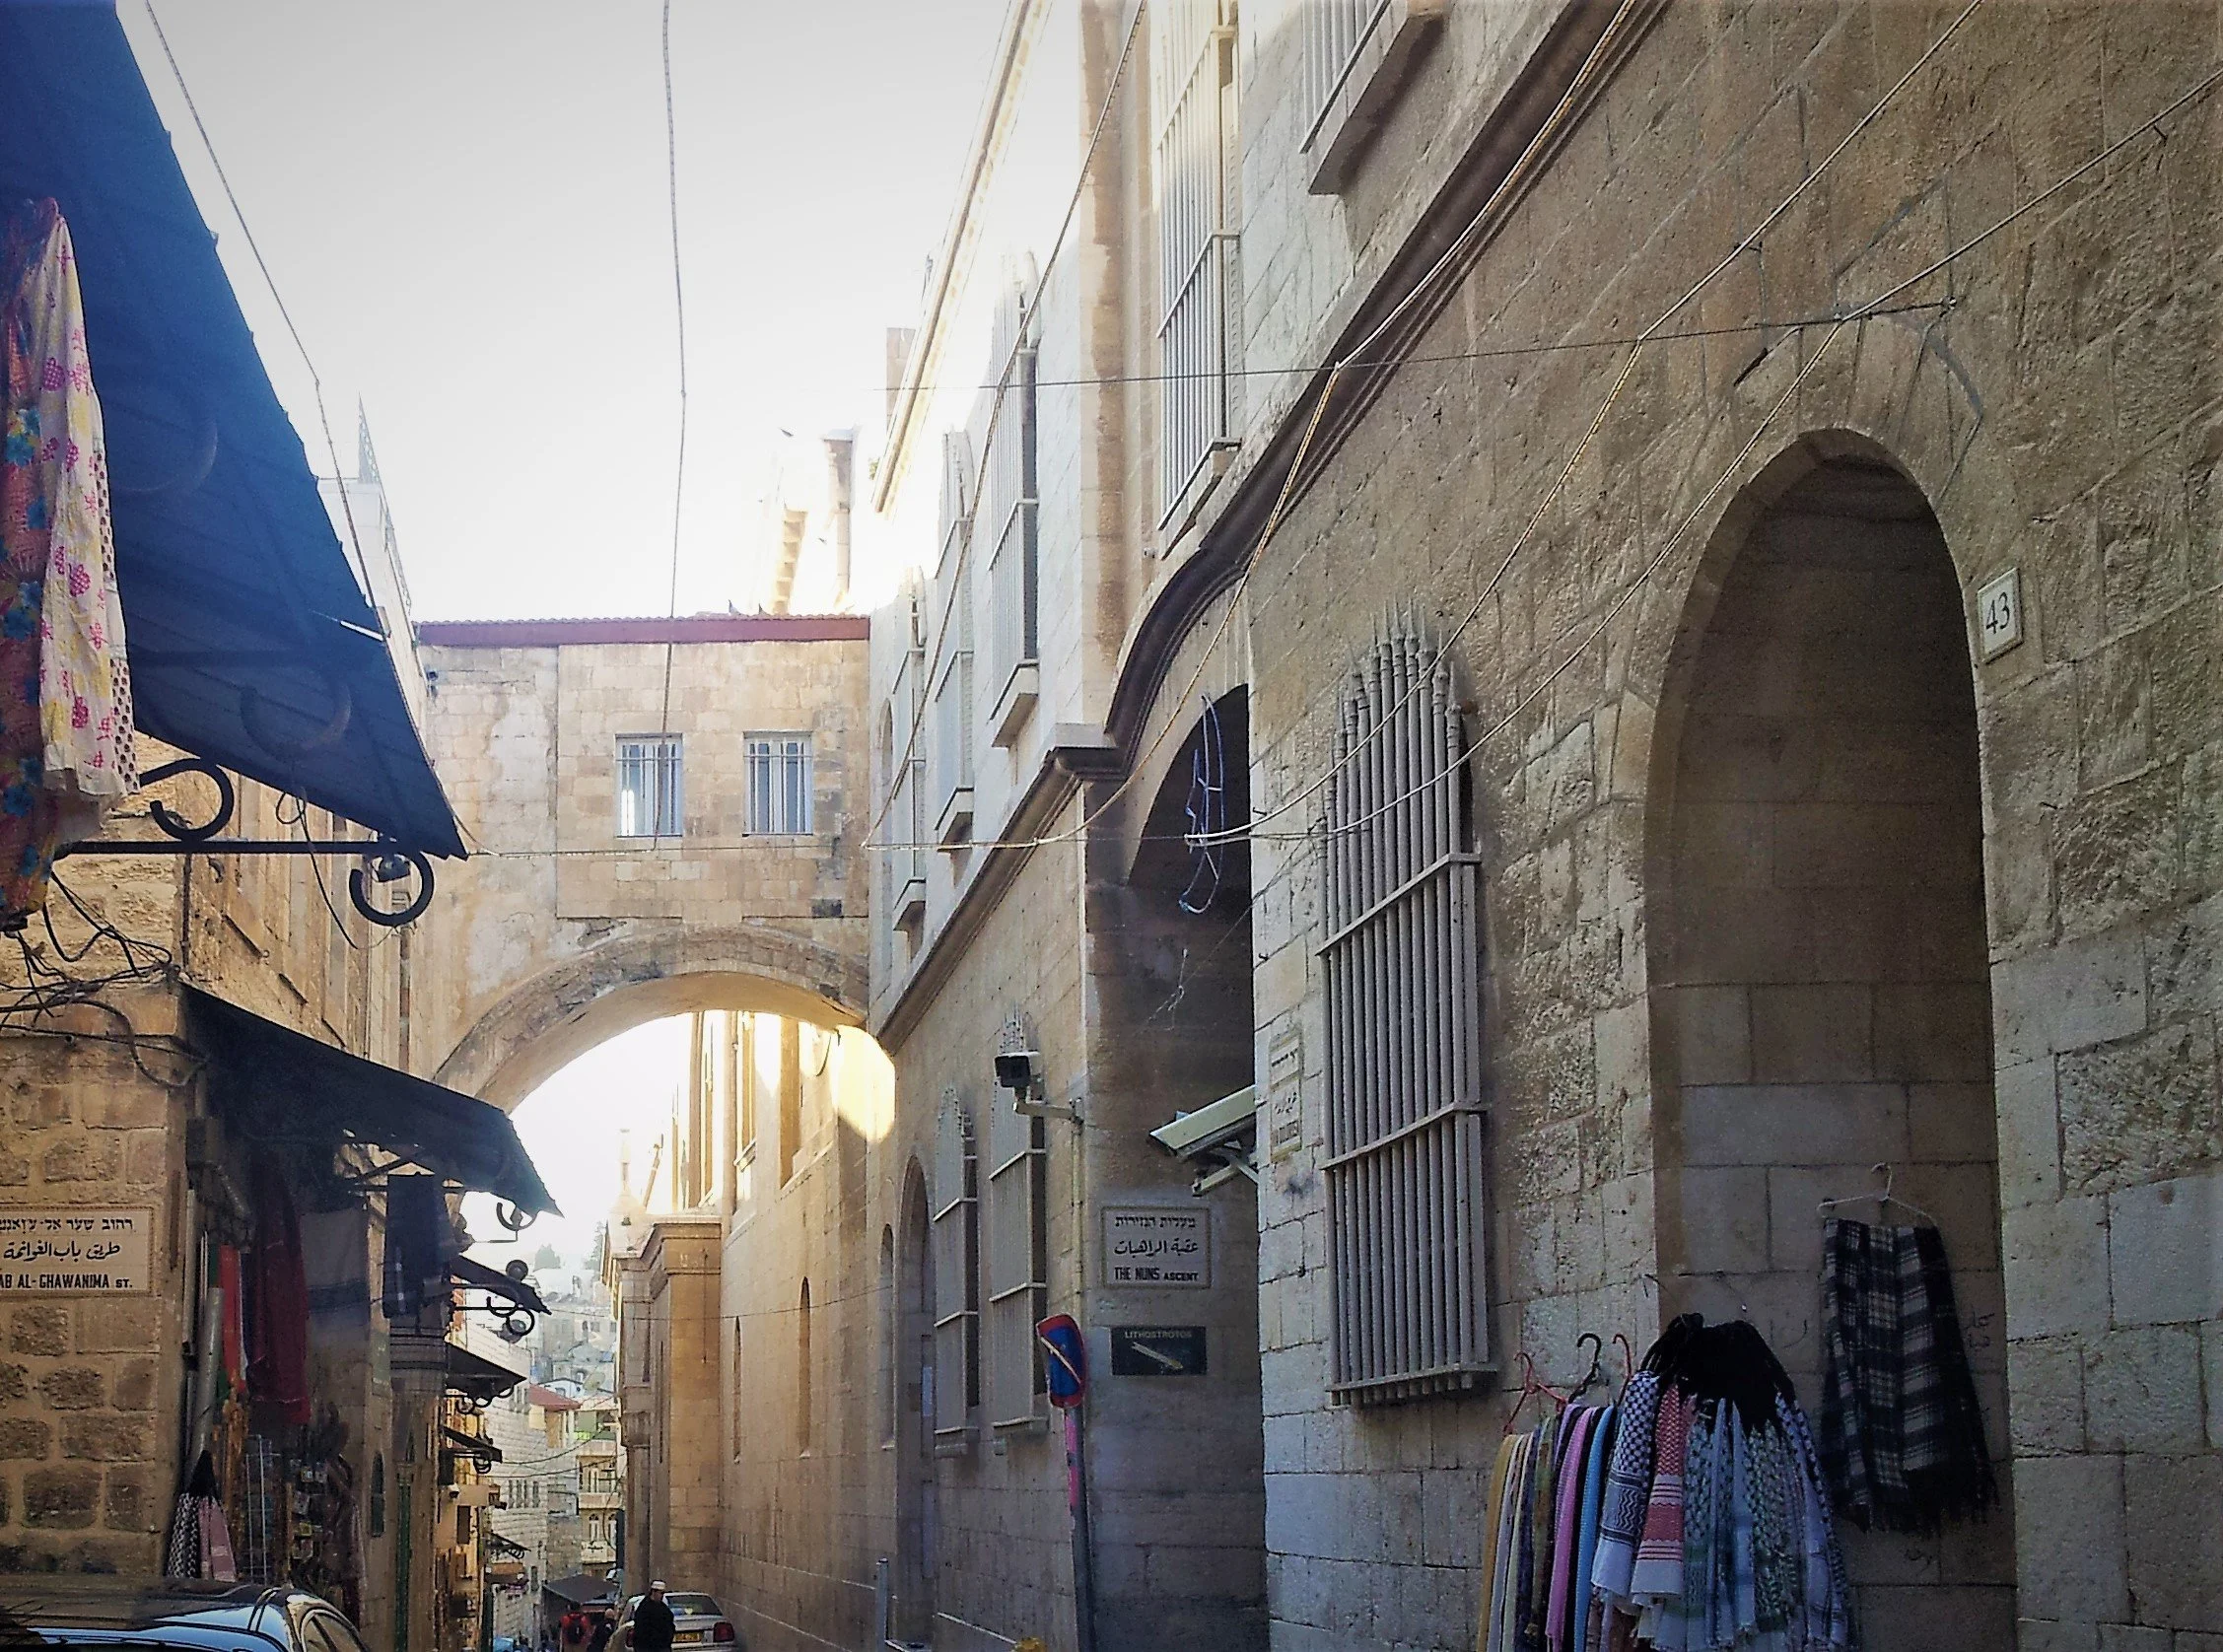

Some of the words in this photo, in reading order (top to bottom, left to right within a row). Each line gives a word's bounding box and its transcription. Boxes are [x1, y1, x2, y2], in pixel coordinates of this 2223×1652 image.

[1985, 591, 2011, 635] 43
[66, 1218, 94, 1232] שער
[102, 1218, 133, 1231] רחוב
[53, 1240, 82, 1263] باب
[86, 1241, 121, 1261] طريق
[1170, 1237, 1199, 1257] عقبة
[1114, 1267, 1132, 1280] THE
[1135, 1267, 1160, 1280] NUNS
[1163, 1272, 1199, 1281] ASCENT
[115, 1278, 133, 1288] ST.
